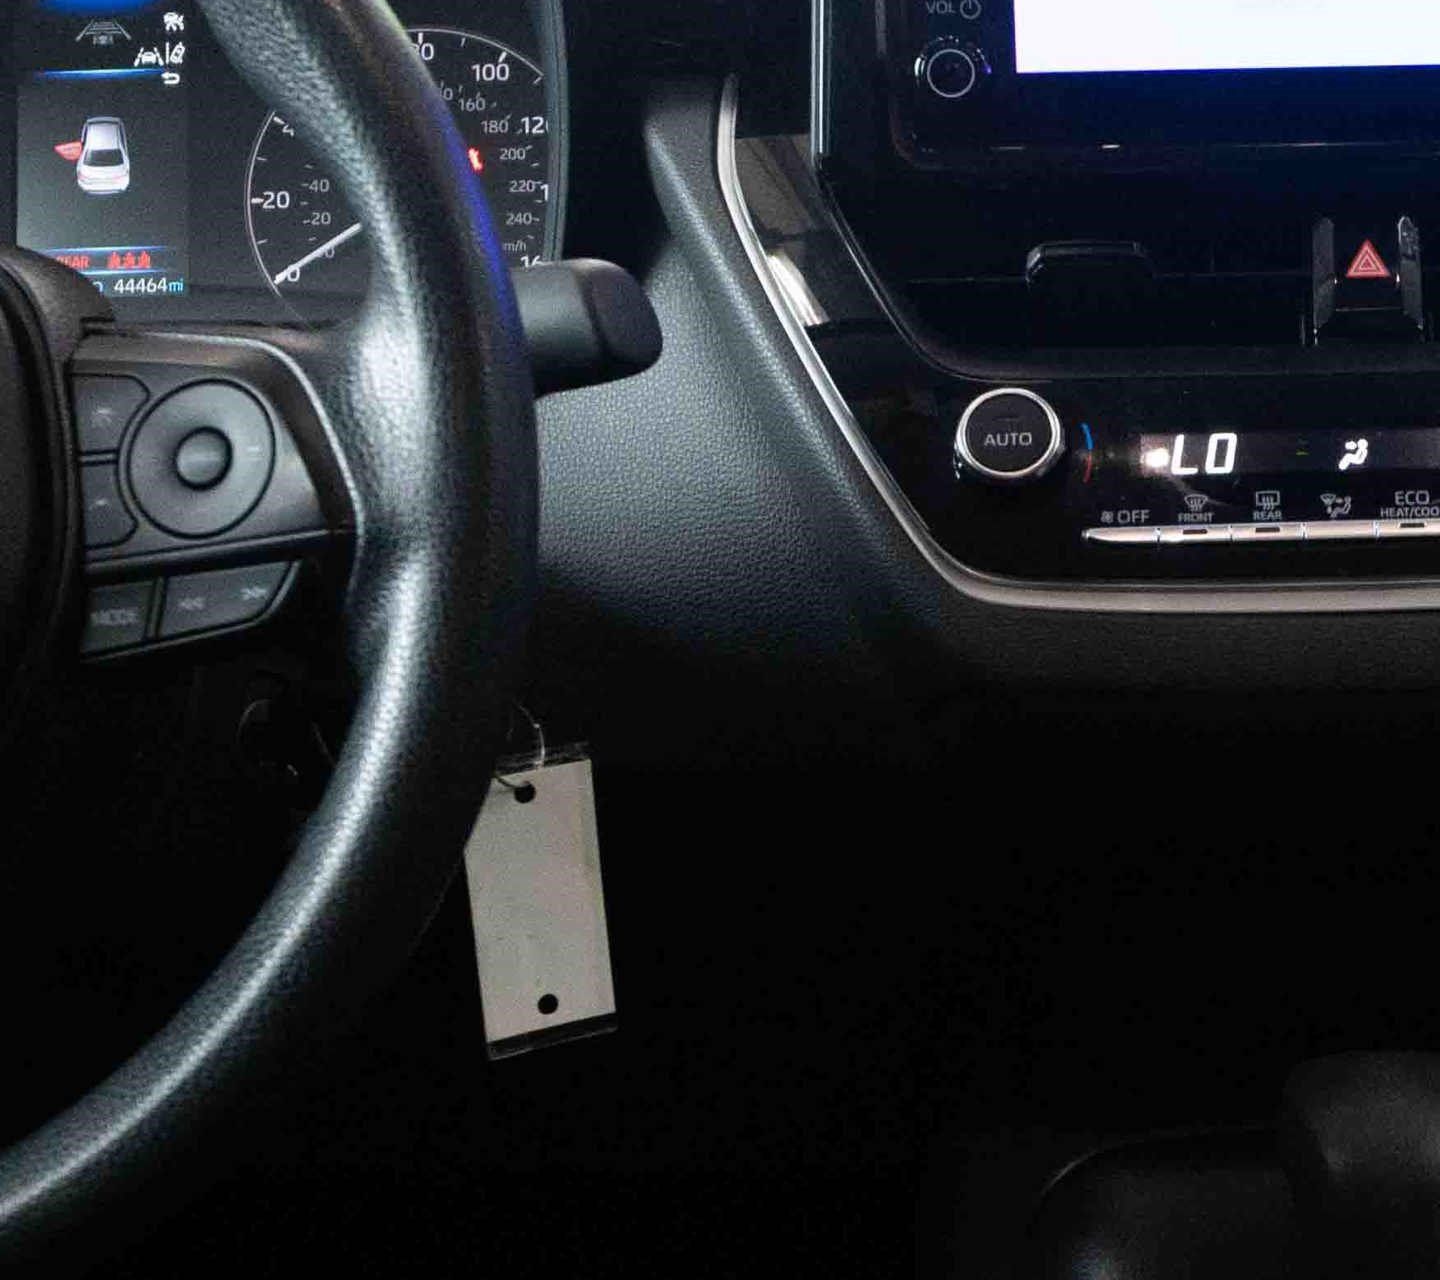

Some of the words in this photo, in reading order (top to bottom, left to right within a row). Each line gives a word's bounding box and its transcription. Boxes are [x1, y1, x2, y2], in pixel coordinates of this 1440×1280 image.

[926, 0, 956, 14] VOL
[472, 63, 510, 82] 100
[458, 98, 486, 112] 160
[481, 120, 509, 135] 180
[521, 116, 549, 134] 12
[499, 147, 526, 161] 200
[309, 178, 330, 193] 40
[509, 179, 536, 193] 220
[262, 191, 290, 209] 20
[311, 211, 332, 226] 20
[505, 212, 533, 225] 240
[502, 240, 527, 252] m/h
[286, 266, 301, 282] 0
[983, 431, 1033, 446] AUTO
[1394, 490, 1429, 506] ECO
[1117, 509, 1150, 523] OFF
[1177, 512, 1215, 523] FRONT
[1253, 510, 1283, 521] REAR
